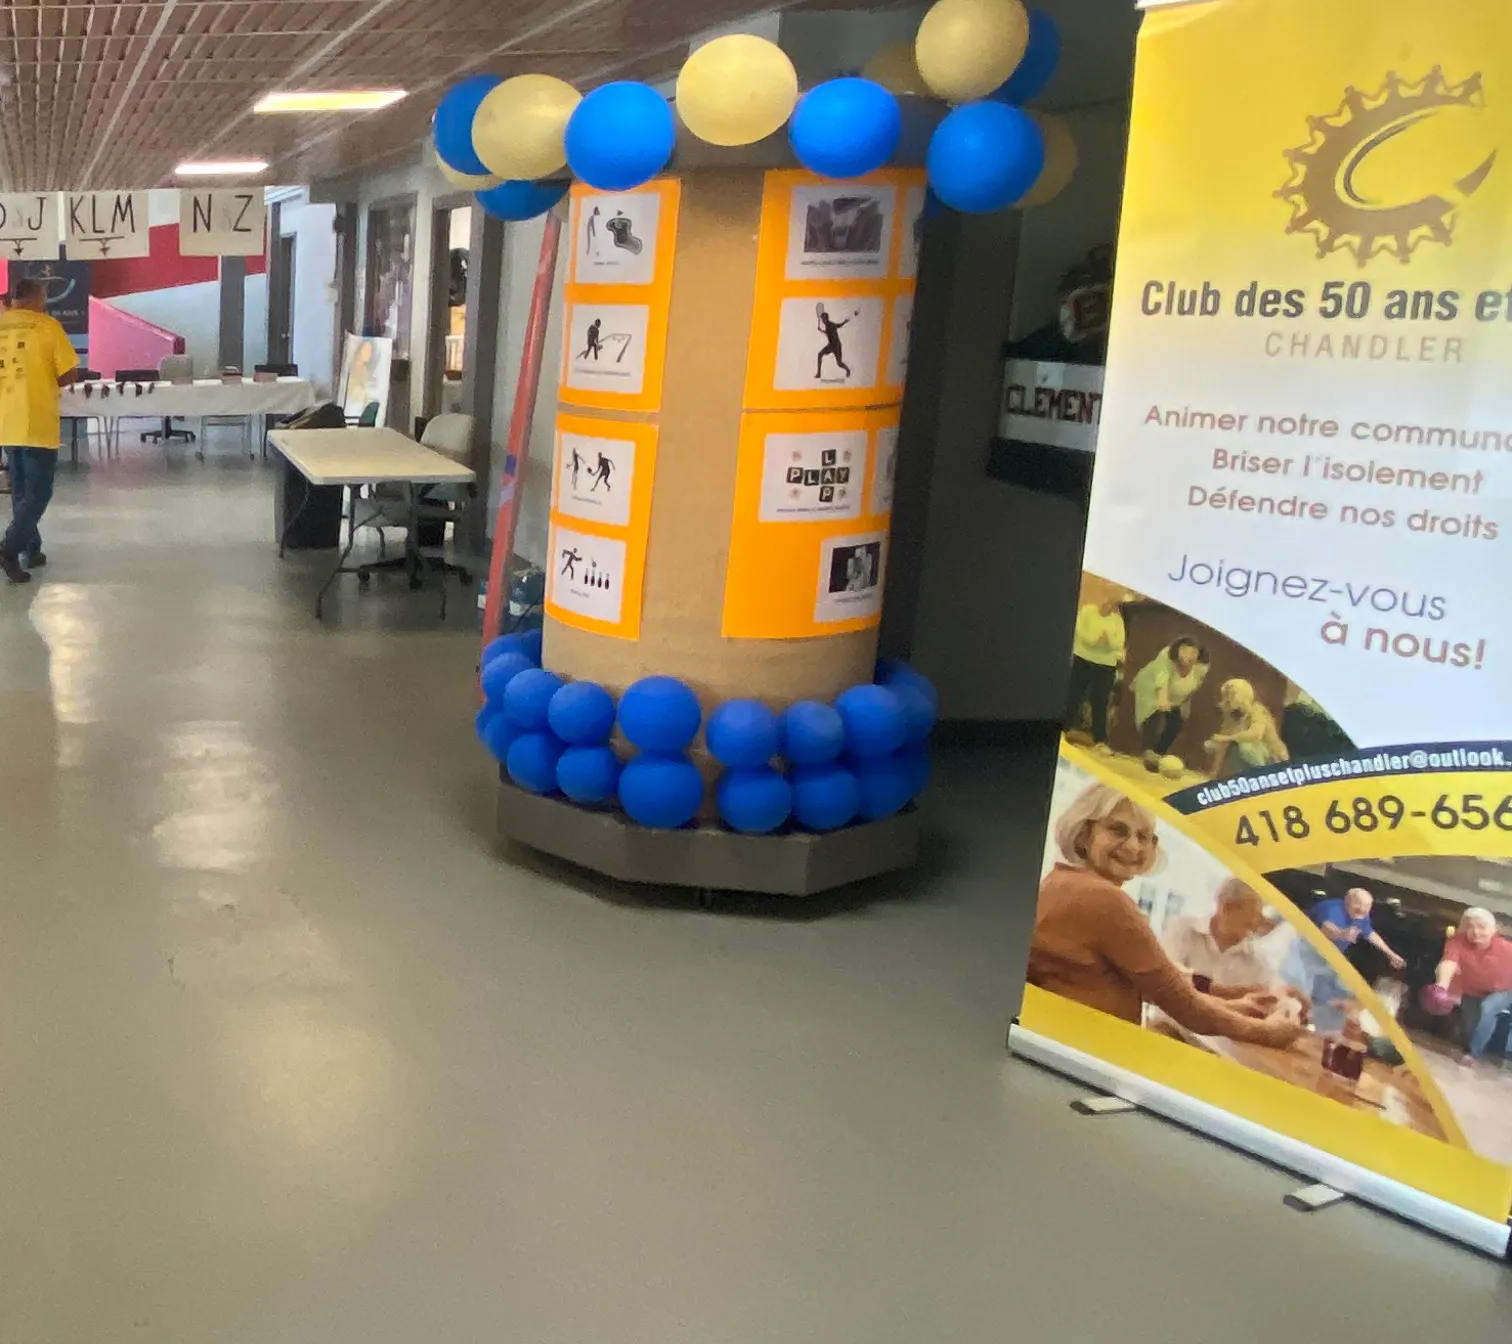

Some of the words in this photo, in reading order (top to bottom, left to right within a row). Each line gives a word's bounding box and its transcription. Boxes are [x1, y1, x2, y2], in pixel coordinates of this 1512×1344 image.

[27, 196, 47, 232] J
[70, 194, 136, 235] KLM
[192, 192, 213, 233] N
[232, 194, 254, 233] Z
[1141, 280, 1221, 317] Club
[1234, 280, 1306, 319] des
[1318, 281, 1372, 320] 50
[1384, 289, 1460, 321] ans
[1264, 330, 1464, 364] CHANDLER
[1144, 404, 1248, 432] Animer
[1256, 413, 1339, 439] notre
[787, 467, 850, 486] PLAY
[1212, 447, 1293, 476] Briser
[1188, 485, 1328, 520] Défendre
[1340, 504, 1396, 529] nos
[1406, 509, 1500, 541] droits
[1167, 554, 1448, 622] Joignez-vous
[1320, 610, 1349, 647] à
[1364, 626, 1487, 671] nous!
[1234, 805, 1311, 847] 418
